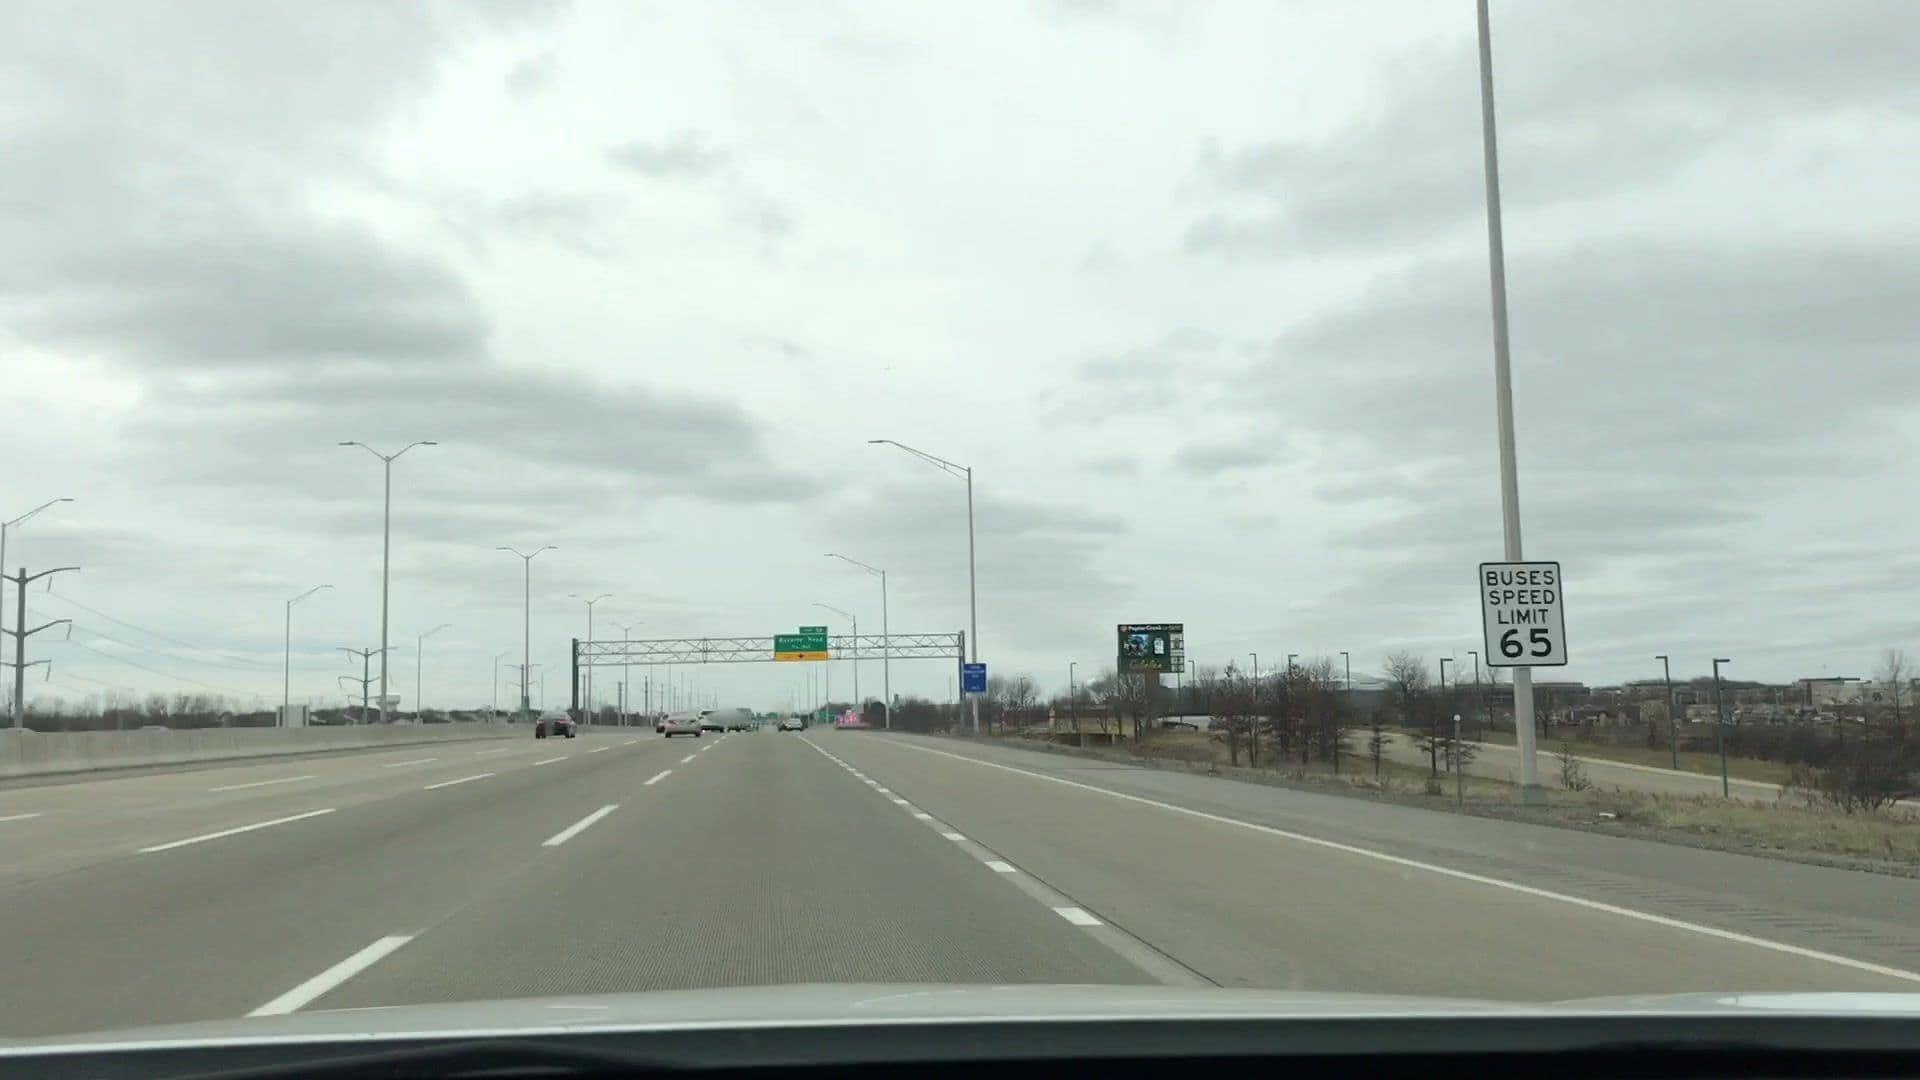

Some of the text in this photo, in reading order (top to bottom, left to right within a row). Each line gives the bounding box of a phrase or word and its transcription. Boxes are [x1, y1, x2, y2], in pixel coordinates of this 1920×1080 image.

[1486, 570, 1554, 586] BUSES
[1489, 589, 1555, 606] SPEED
[1497, 608, 1549, 625] LIMIT
[1500, 628, 1552, 658] 65
